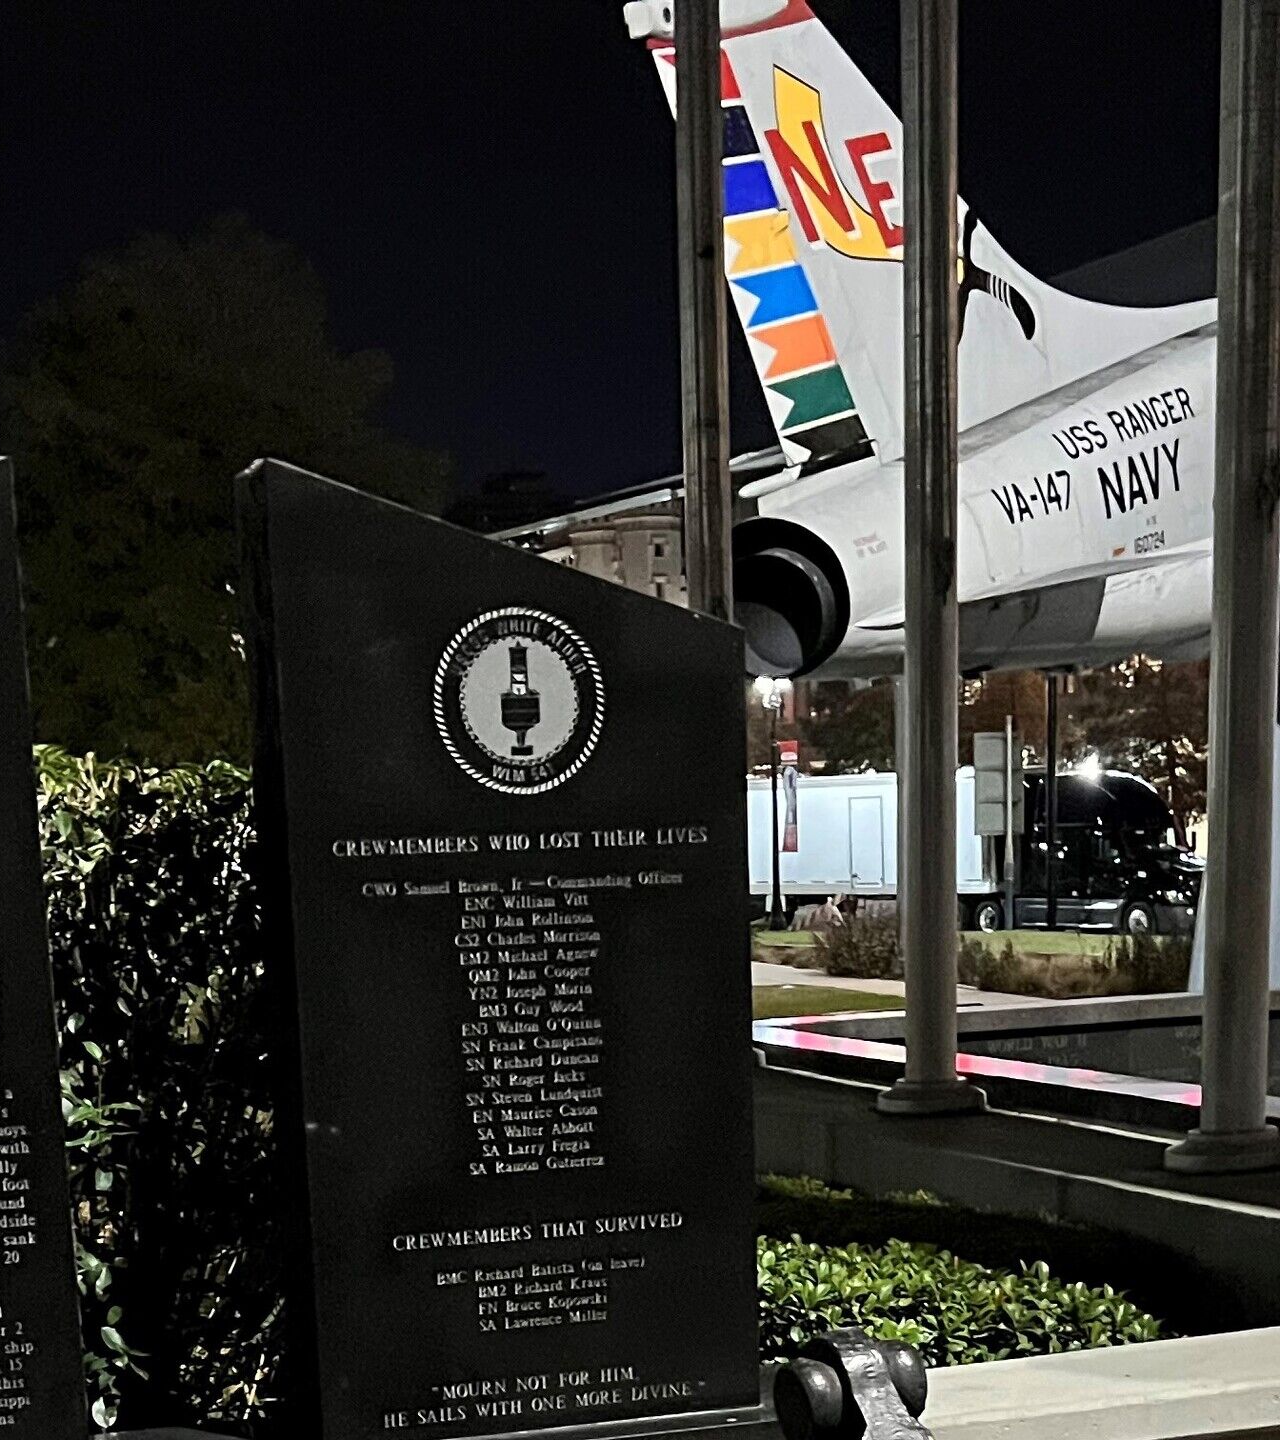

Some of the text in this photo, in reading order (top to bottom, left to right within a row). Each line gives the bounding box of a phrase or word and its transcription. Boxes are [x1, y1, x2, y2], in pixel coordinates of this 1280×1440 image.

[764, 121, 903, 249] NE
[1052, 387, 1195, 459] USS RANGER
[991, 438, 1180, 524] VA-147 NAVY
[331, 826, 708, 857] CREWMEMBERS WHO LOST THEIR LIVES
[4, 1088, 14, 1100] a
[0, 1176, 30, 1192] foot
[391, 1211, 683, 1252] CREWMEMBERS THAT SURVIVED
[515, 1374, 547, 1393] NOT
[558, 1370, 591, 1388] FOR
[383, 1411, 408, 1429] HE
[416, 1404, 467, 1425] SAILS
[474, 1398, 523, 1417] WITH
[529, 1393, 566, 1412] ONE
[574, 1389, 622, 1407] MORE
